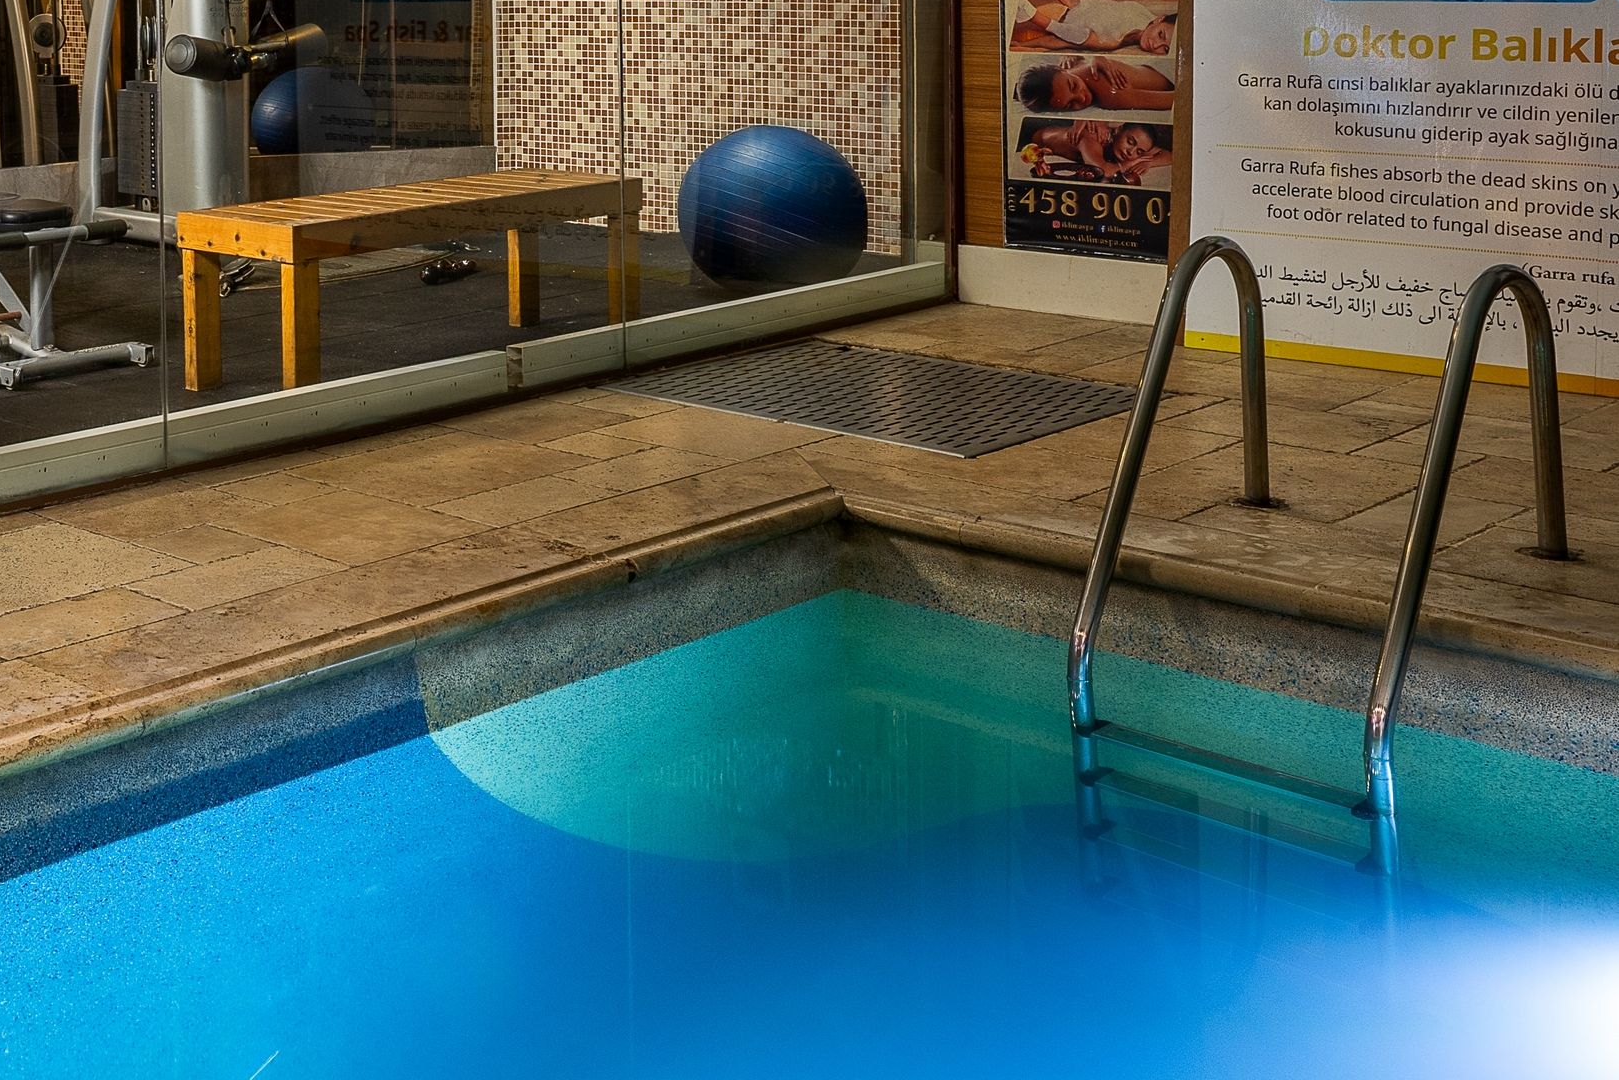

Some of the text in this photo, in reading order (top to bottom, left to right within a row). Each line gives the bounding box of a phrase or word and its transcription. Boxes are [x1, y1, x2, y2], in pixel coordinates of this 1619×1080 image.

[1303, 25, 1457, 60] Doktor
[1237, 73, 1282, 88] Garra
[1369, 76, 1432, 93] balıklar
[1435, 79, 1568, 98] ayaklarınızdaki
[1574, 82, 1603, 99] ölü
[1264, 95, 1292, 111] kan
[1296, 97, 1380, 117] dolaşımını
[1386, 100, 1473, 118] hızlandırır
[1476, 107, 1498, 120] ve
[1502, 104, 1550, 122] cildin
[1335, 120, 1618, 152] kokusunu giderip ayak sağlığına
[1241, 158, 1607, 195] Garra Rufa fishes absorb the dead skins on
[1019, 187, 1079, 217] 458
[1092, 193, 1130, 221] 90
[1251, 182, 1595, 218] accelerate blood circulation and provide
[1266, 203, 1603, 244] foot odor related to fungal disease and
[1582, 272, 1616, 286] rufa
